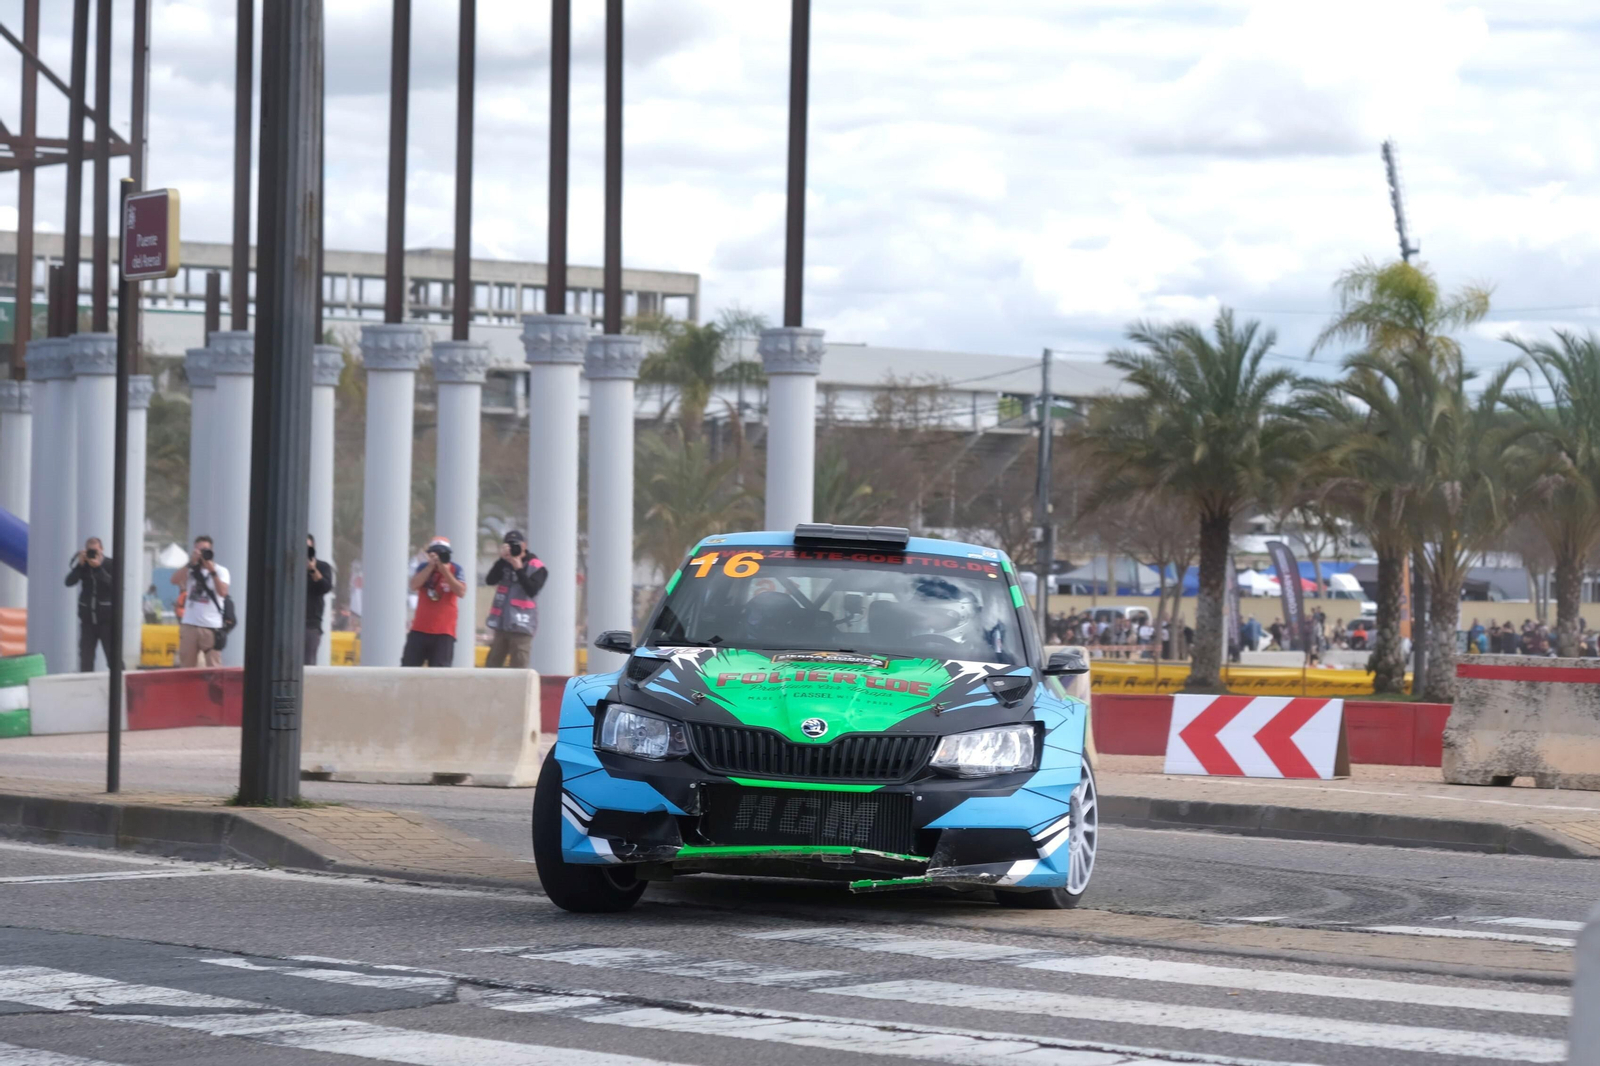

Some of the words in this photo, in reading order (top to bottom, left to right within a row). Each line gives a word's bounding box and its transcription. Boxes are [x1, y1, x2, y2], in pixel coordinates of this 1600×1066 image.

[136, 233, 158, 247] Puente
[131, 254, 142, 269] del
[143, 252, 162, 267] Arenal
[690, 552, 765, 578] 16
[702, 549, 998, 574] W.ZELTE-GOETTIG.DE
[516, 613, 530, 623] 12
